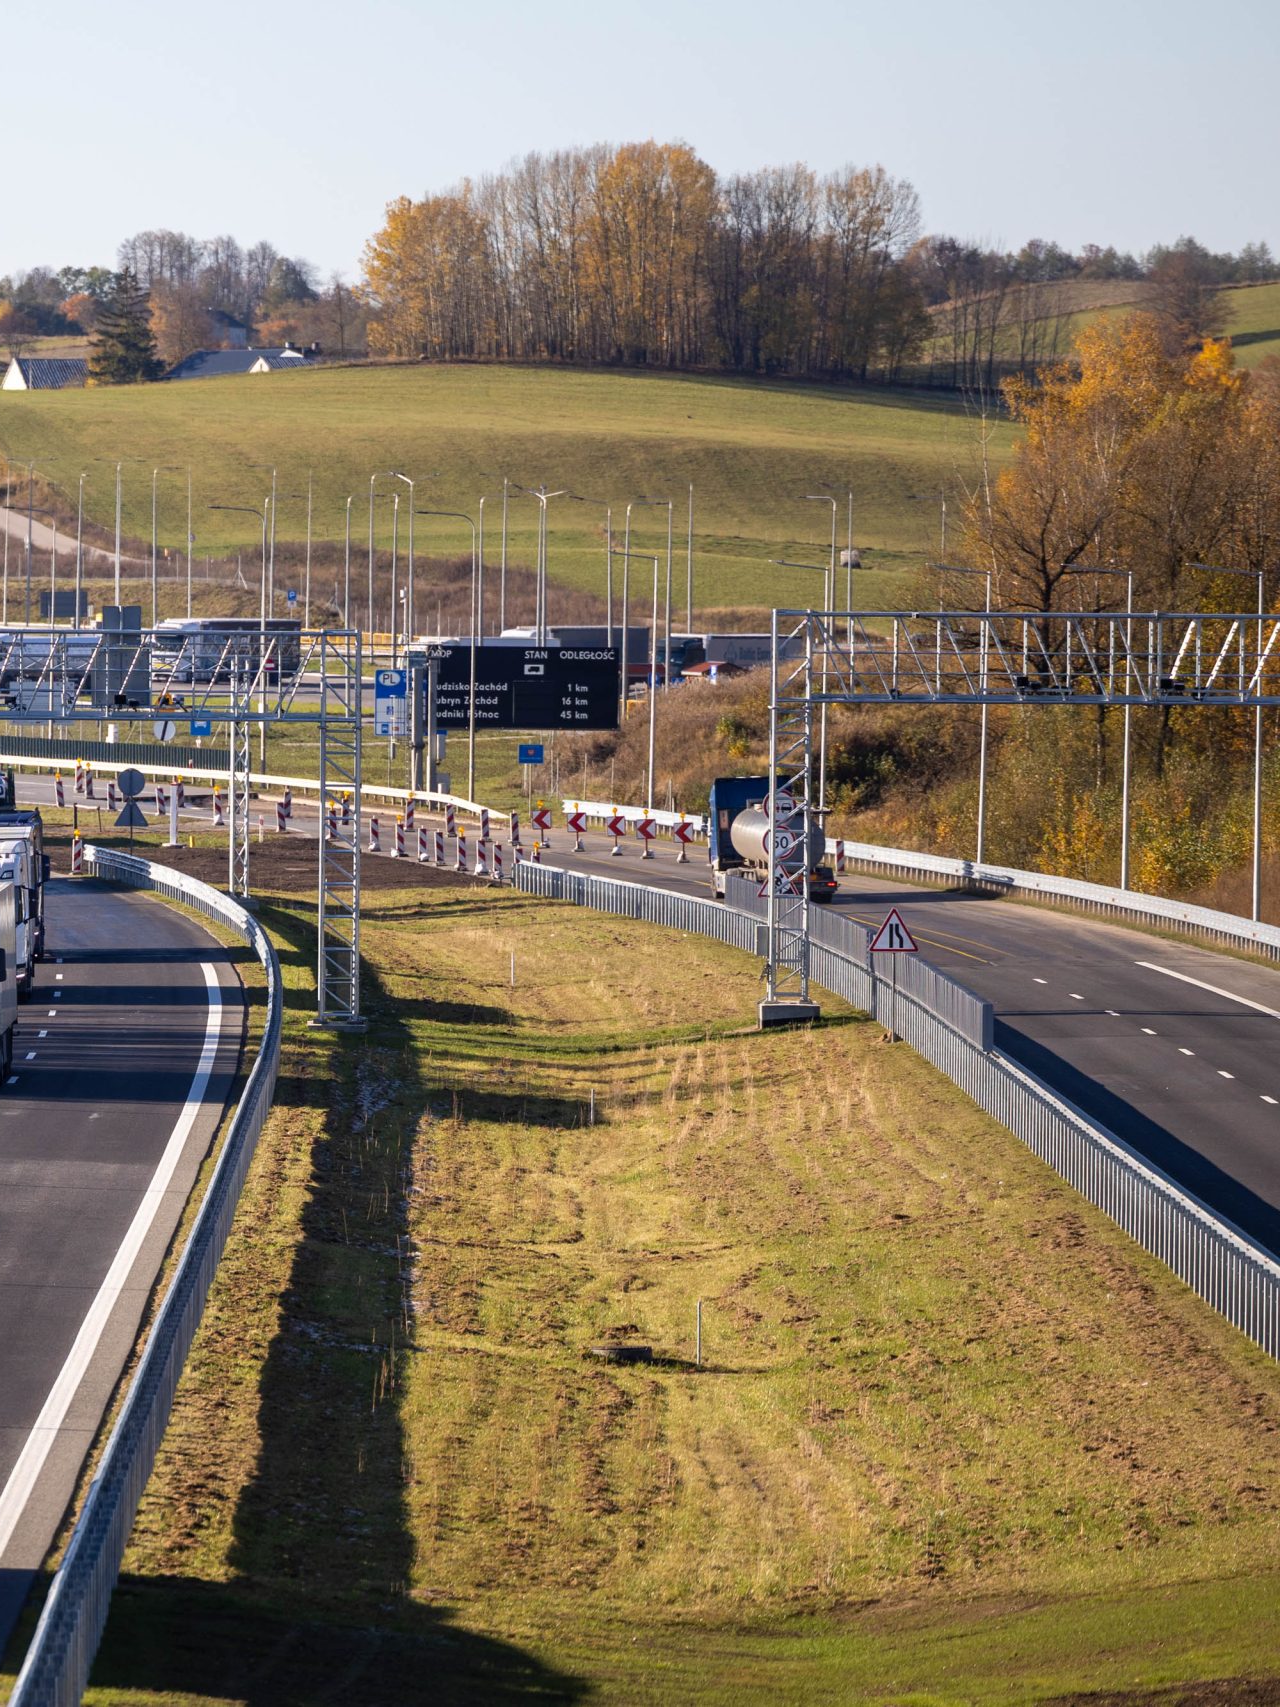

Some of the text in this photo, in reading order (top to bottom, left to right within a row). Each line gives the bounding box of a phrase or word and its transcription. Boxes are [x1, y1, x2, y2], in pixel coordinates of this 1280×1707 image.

[524, 648, 615, 660] STAN ODLEGŁOŚĆ
[383, 674, 396, 684] PL
[436, 682, 588, 692] udzisko Zachód 1 km
[436, 696, 588, 707] ubryn Zchód 16 km
[436, 709, 464, 718] udniki
[560, 710, 572, 719] 45
[575, 710, 588, 719] km
